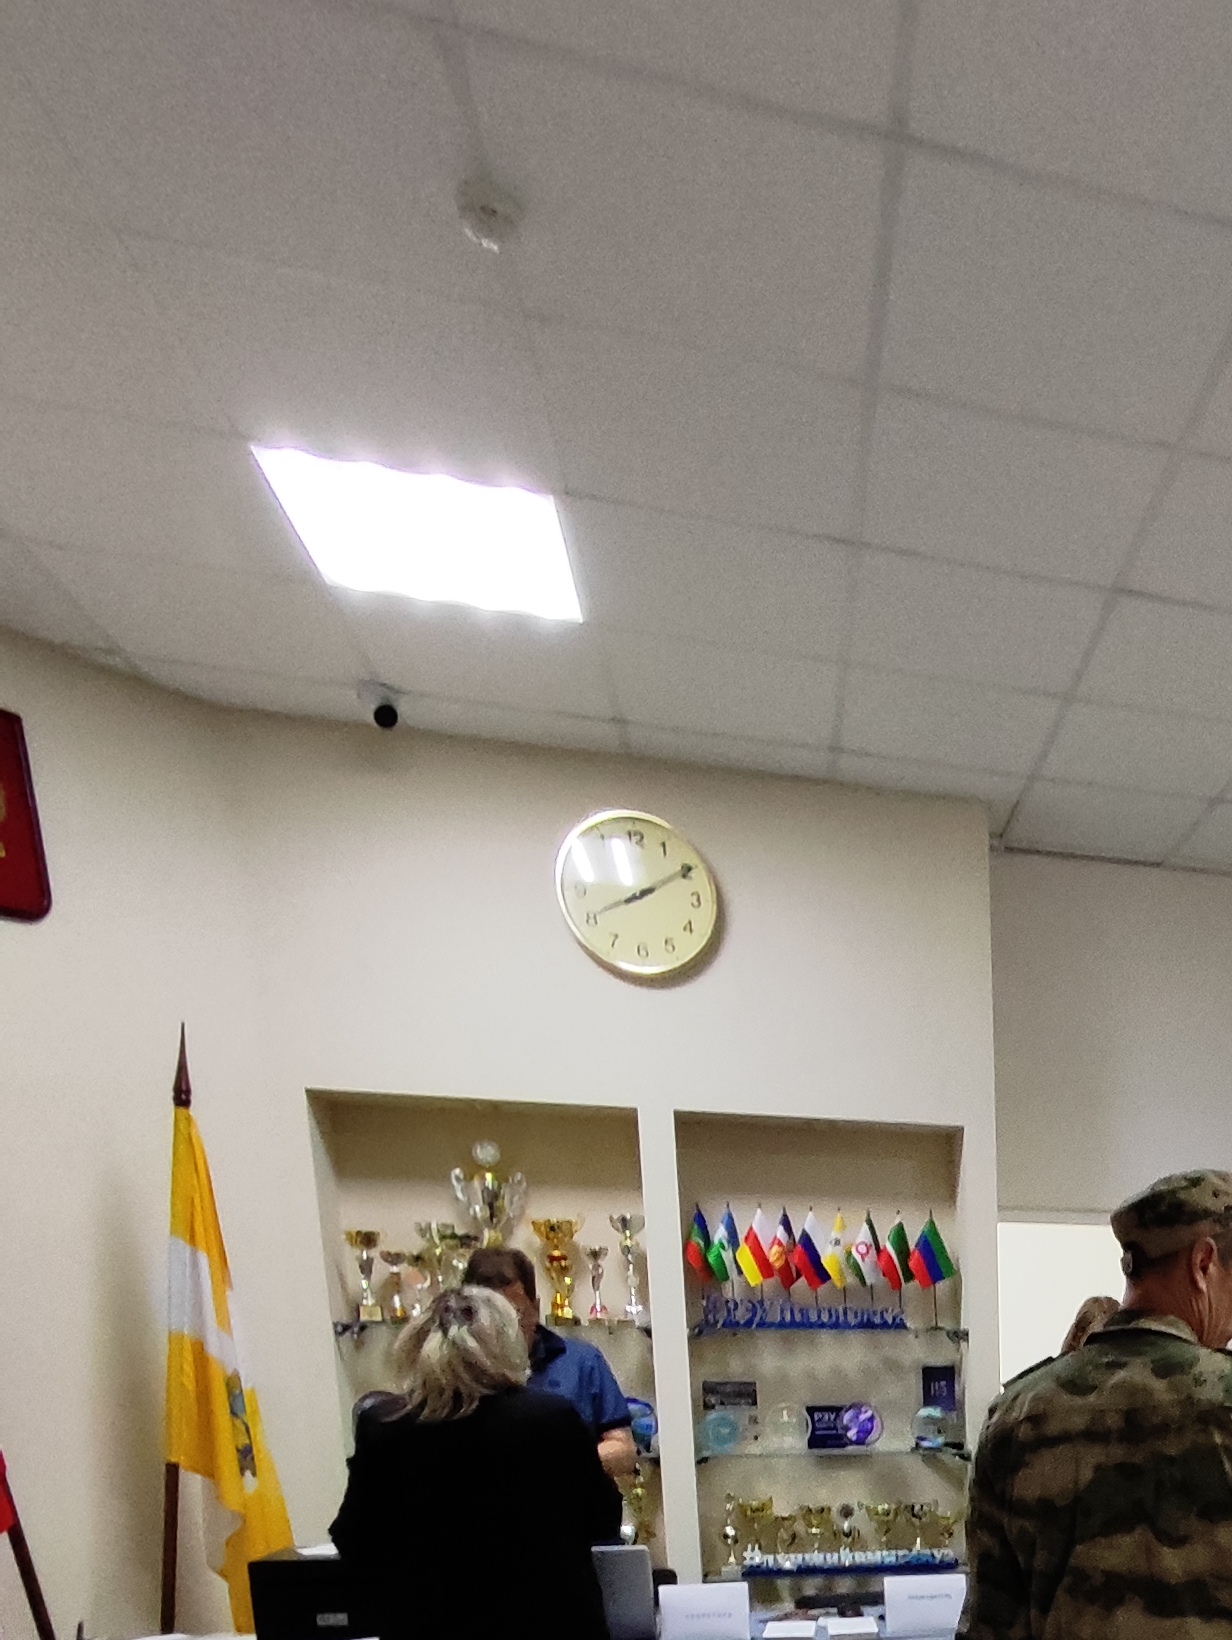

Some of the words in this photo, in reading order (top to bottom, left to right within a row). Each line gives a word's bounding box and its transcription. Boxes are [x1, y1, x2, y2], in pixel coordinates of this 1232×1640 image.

[627, 829, 645, 849] 12
[661, 841, 667, 857] 1
[691, 891, 702, 908] 3
[586, 912, 598, 927] 8
[683, 920, 694, 935] 4
[609, 931, 620, 949] 7
[664, 937, 676, 954] 5
[637, 942, 649, 958] 6
